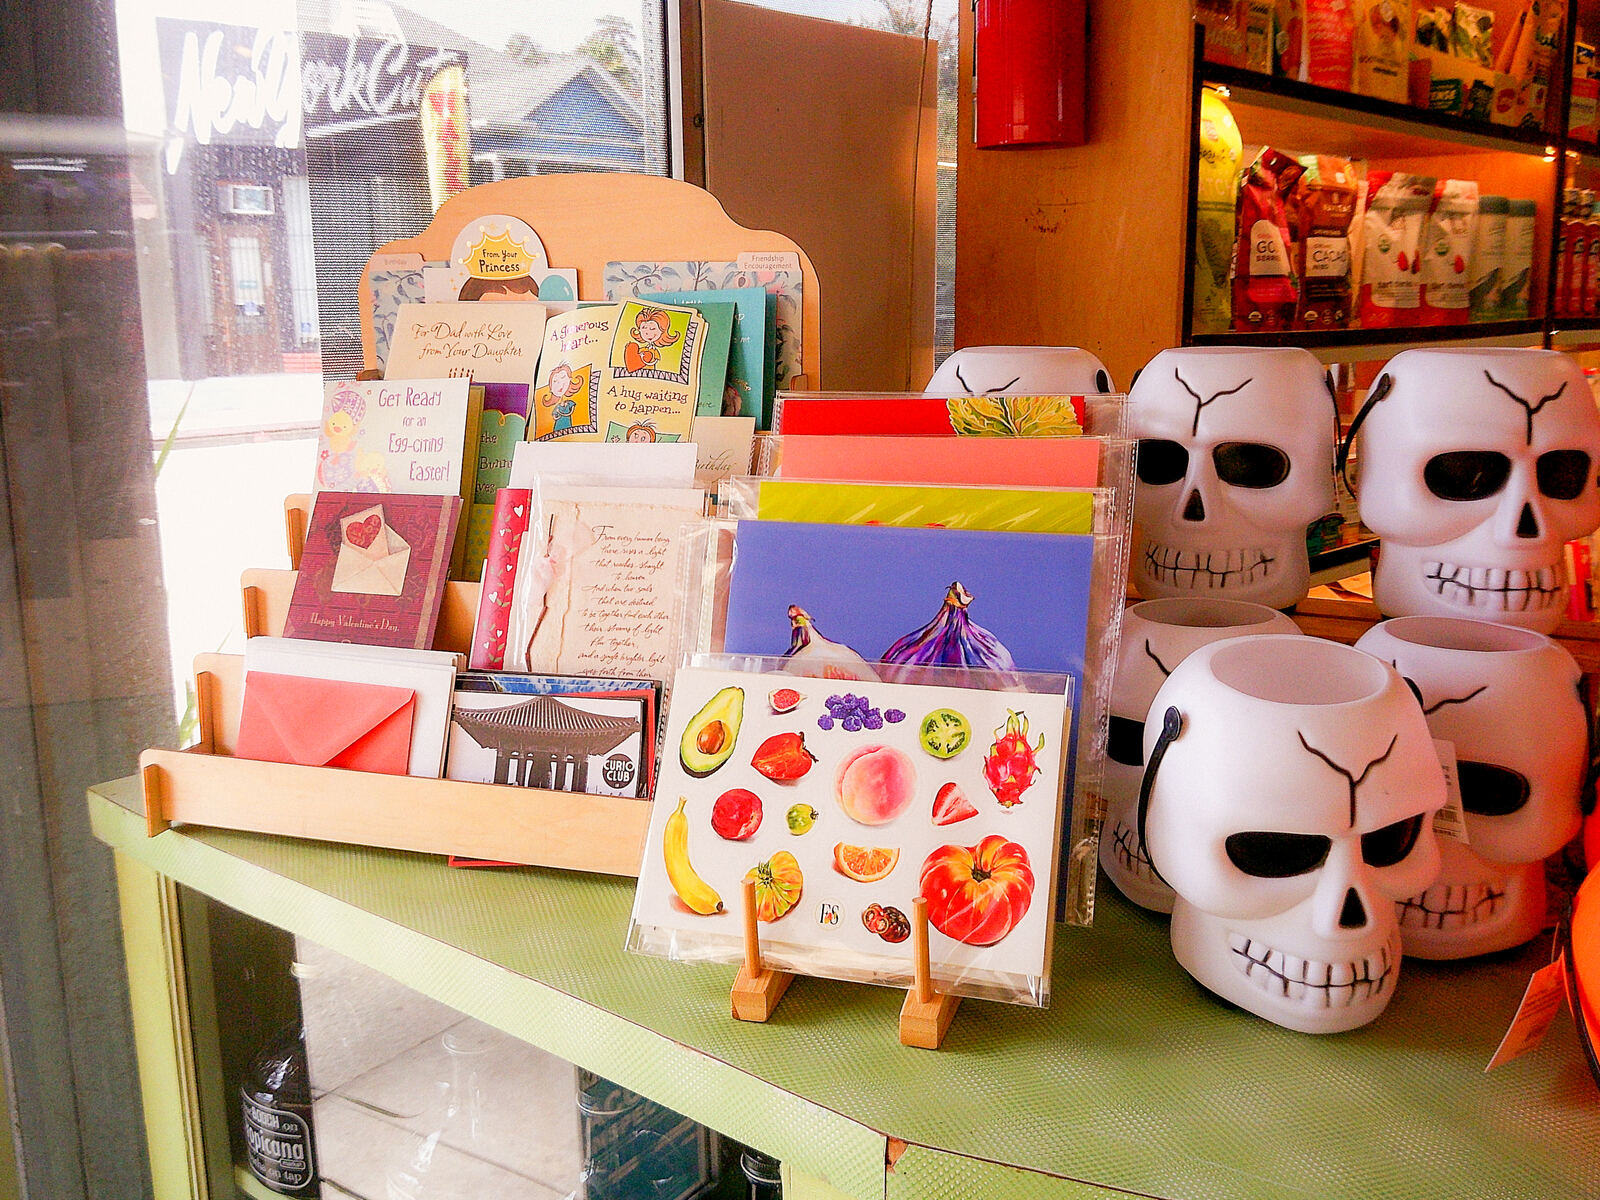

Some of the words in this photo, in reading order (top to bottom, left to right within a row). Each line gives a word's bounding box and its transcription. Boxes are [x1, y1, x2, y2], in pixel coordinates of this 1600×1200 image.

[482, 249, 500, 258] From
[501, 249, 518, 262] Your
[751, 254, 785, 262] Friendship
[478, 259, 520, 273] Princess
[743, 262, 793, 271] Encouragement
[411, 323, 430, 340] For
[431, 321, 468, 340] Dad
[464, 323, 485, 338] with
[487, 322, 513, 341] Love
[550, 329, 559, 342] A
[418, 342, 442, 360] from
[443, 341, 471, 359] Your
[471, 340, 523, 364] Daughter
[378, 388, 401, 408] Get
[405, 386, 442, 408] Ready
[607, 385, 617, 398] A
[620, 385, 642, 403] hug
[644, 389, 689, 404] waiting
[615, 400, 627, 412] to
[402, 415, 415, 427] for
[416, 416, 427, 427] an
[388, 432, 444, 454] Egg-citing
[480, 431, 498, 444] the
[409, 460, 450, 482] Easter!
[591, 525, 615, 545] From
[616, 535, 633, 546] every
[601, 544, 618, 554] there
[648, 546, 667, 559] light
[593, 559, 612, 568] that
[582, 583, 606, 593] And
[605, 583, 622, 592] when
[638, 583, 653, 593] souls
[595, 596, 615, 605] that
[628, 597, 656, 606] destined
[309, 612, 336, 628] Happy
[337, 614, 380, 629] Valentine's
[598, 609, 623, 622] together
[624, 609, 641, 619] find
[638, 610, 654, 619] each
[653, 611, 670, 620] other
[584, 623, 603, 633] their
[633, 624, 643, 637] of
[644, 623, 664, 639] light
[590, 636, 605, 647] flow
[578, 650, 596, 660] and
[648, 652, 667, 667] light
[598, 666, 618, 677] forth
[618, 667, 635, 678] from
[603, 759, 635, 772] CURIO
[606, 769, 630, 783] CLUB
[281, 1122, 299, 1133] on
[283, 1170, 303, 1184] tap
